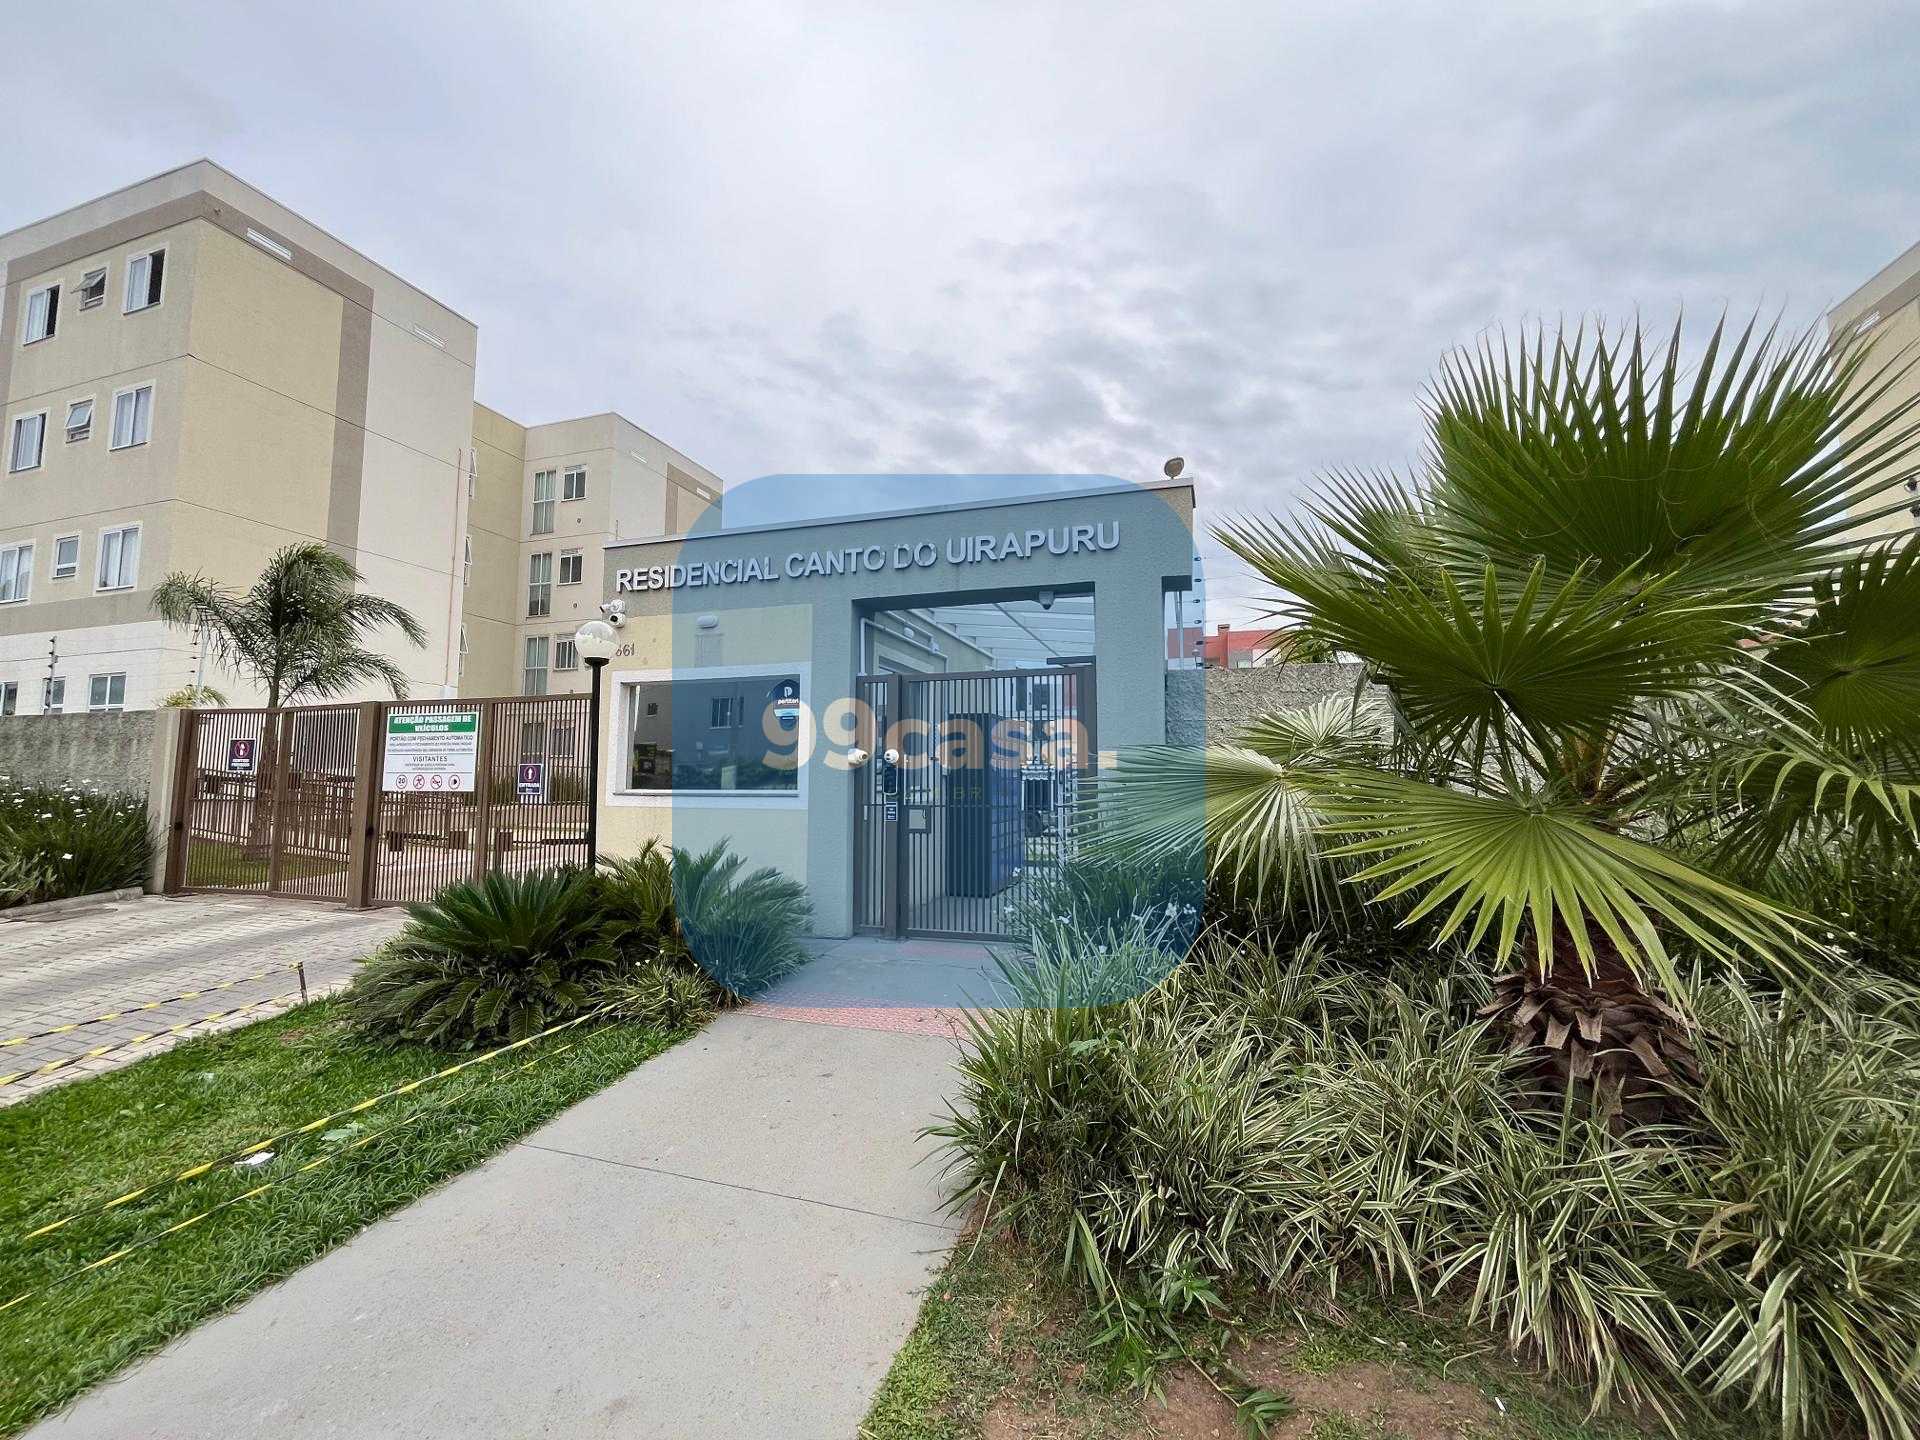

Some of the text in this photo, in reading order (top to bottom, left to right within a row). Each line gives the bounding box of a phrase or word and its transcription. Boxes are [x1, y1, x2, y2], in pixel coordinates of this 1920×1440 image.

[616, 521, 1120, 593] RESIDENCIAL CANTO DO UIRAPURU
[394, 715, 424, 724] ATENÇÃO
[425, 715, 461, 723] PASSAGEM
[415, 724, 449, 732] VEÍCULOS
